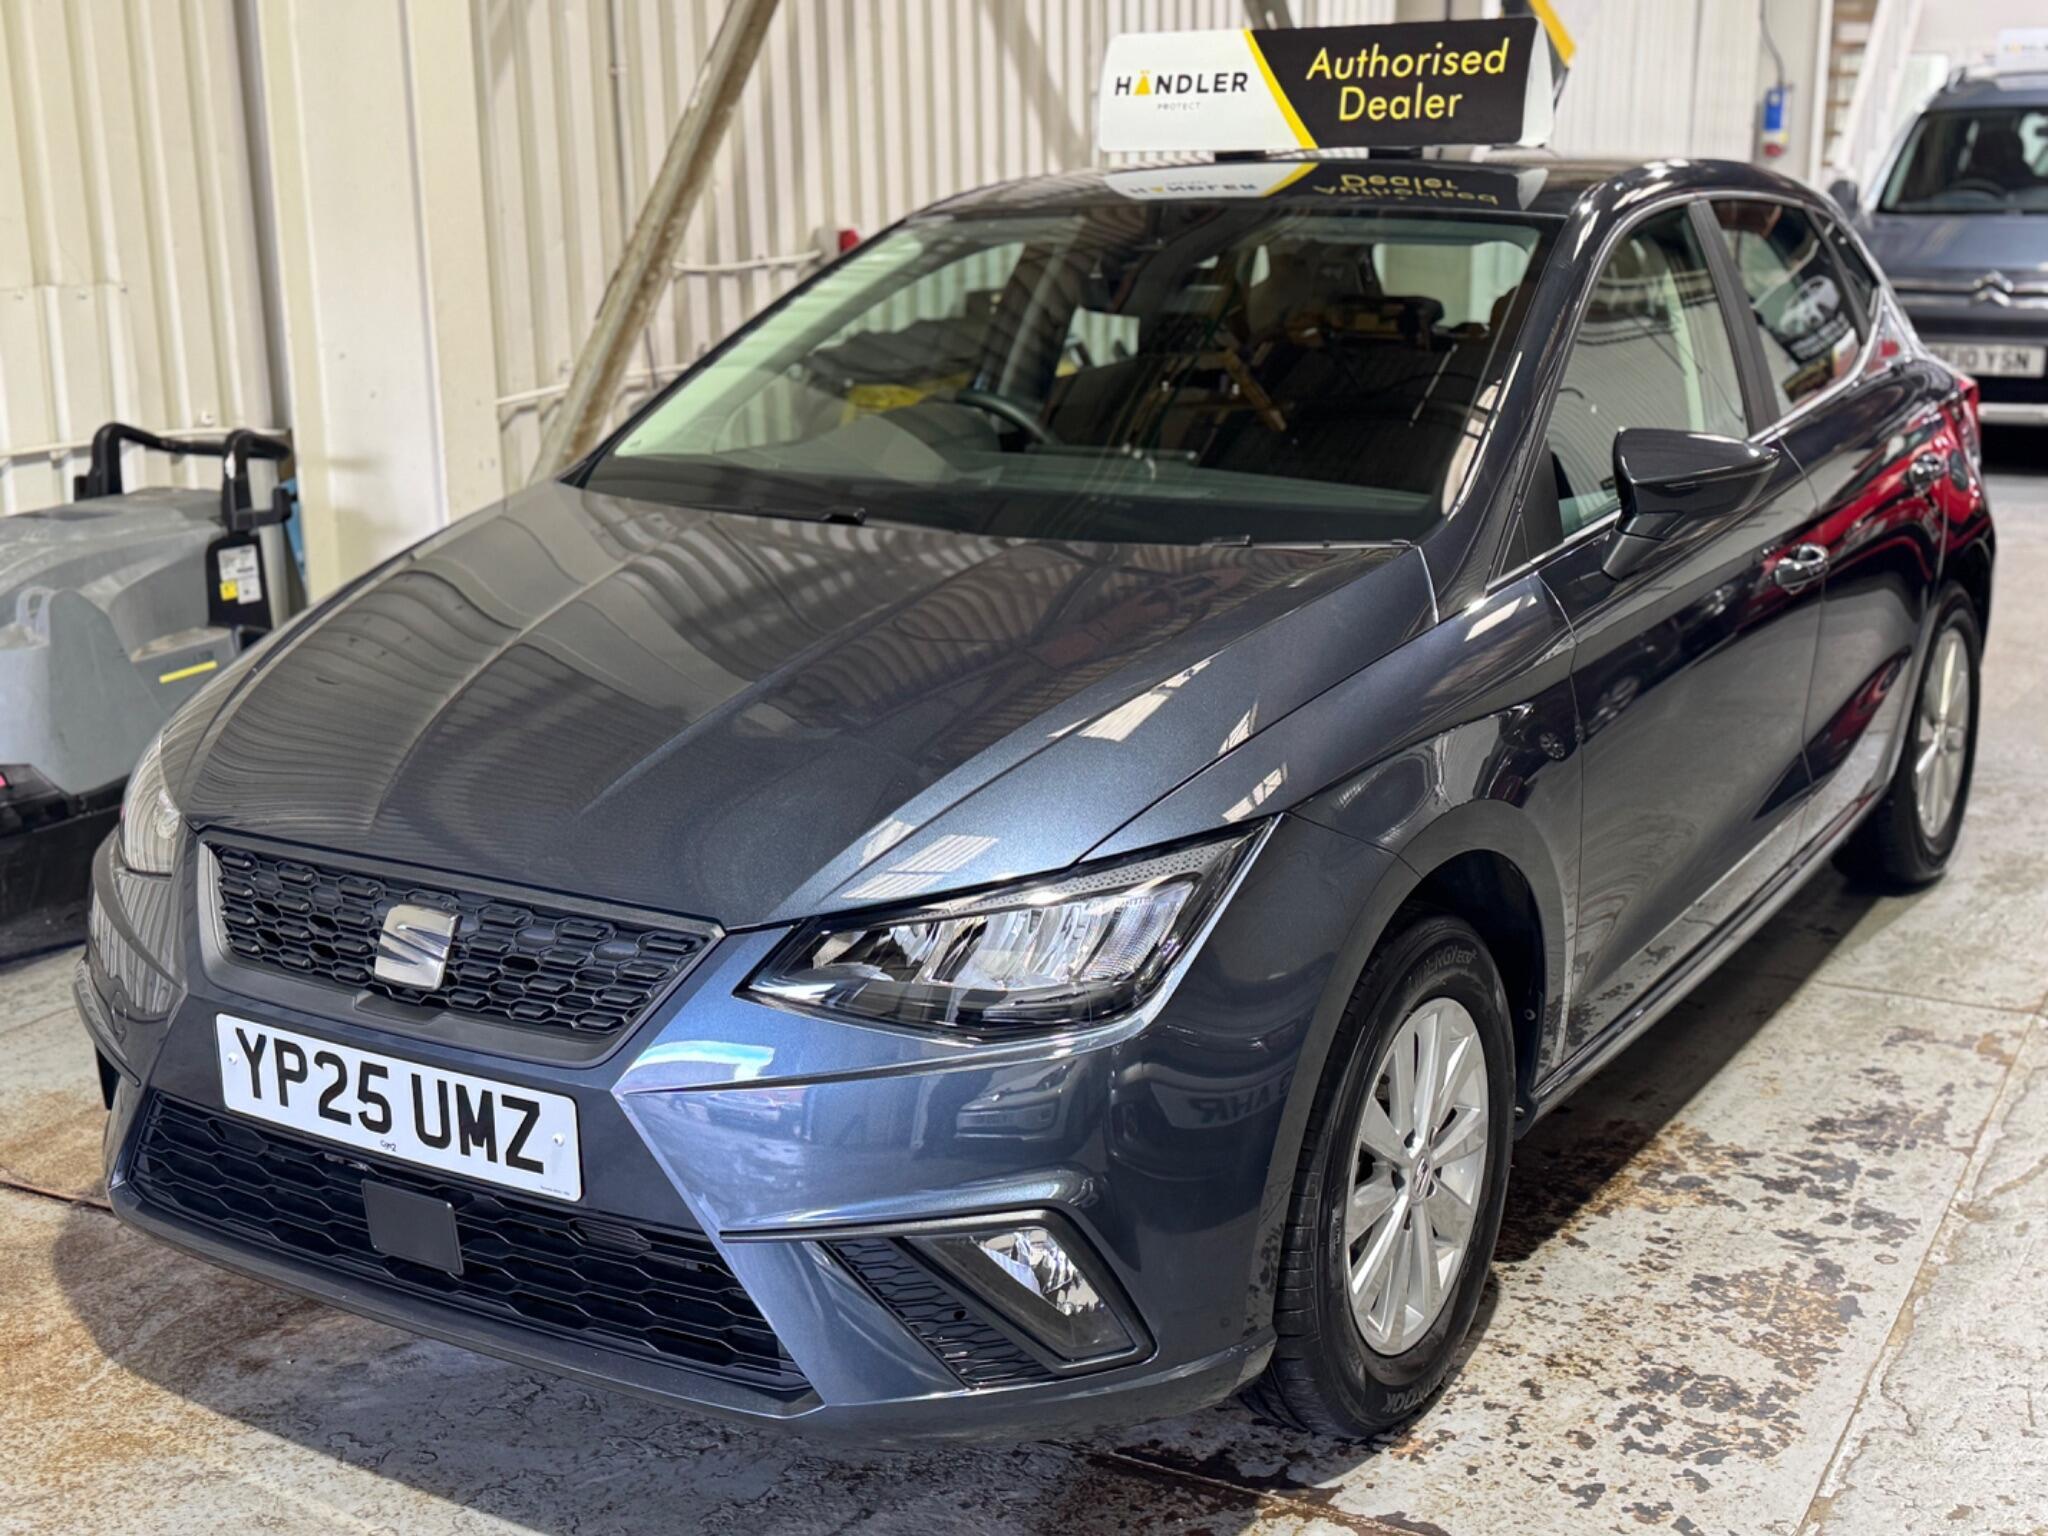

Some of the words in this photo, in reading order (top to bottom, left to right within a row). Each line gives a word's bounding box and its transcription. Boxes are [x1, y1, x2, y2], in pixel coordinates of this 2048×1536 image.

[1307, 38, 1509, 81] Authorised
[1157, 102, 1201, 111] PROTECT
[1338, 84, 1463, 122] Dealer
[236, 1027, 393, 1135] YP25
[411, 1072, 545, 1176] UMZ
